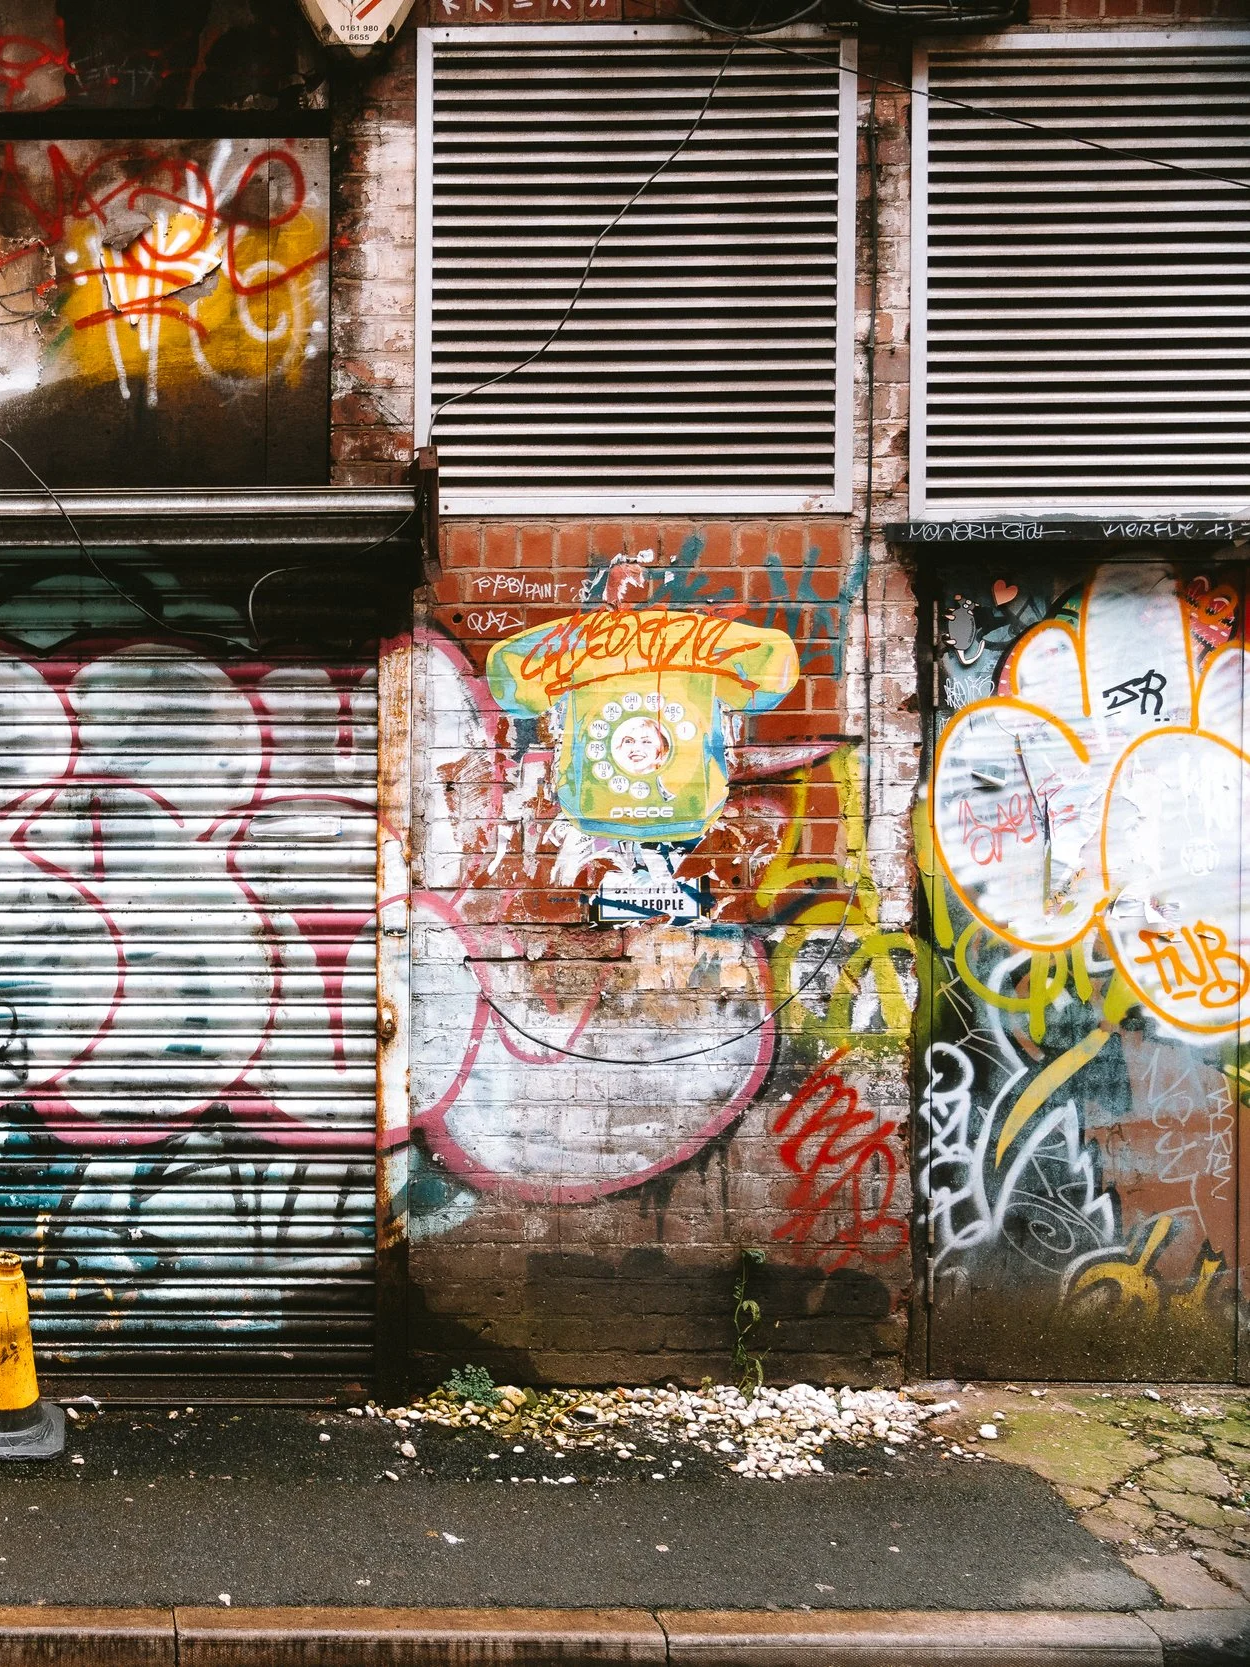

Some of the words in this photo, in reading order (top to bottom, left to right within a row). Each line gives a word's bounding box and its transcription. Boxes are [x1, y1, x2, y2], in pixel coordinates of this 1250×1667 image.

[624, 695, 638, 703] GHI
[605, 705, 619, 714] JKL
[628, 703, 634, 711] 4
[664, 706, 681, 714] ABC
[609, 713, 615, 721] 5
[670, 713, 676, 721] 2
[596, 730, 602, 738] 6
[601, 770, 607, 778] 8
[613, 777, 626, 785] WXY
[641, 899, 684, 911] PEOPLE
